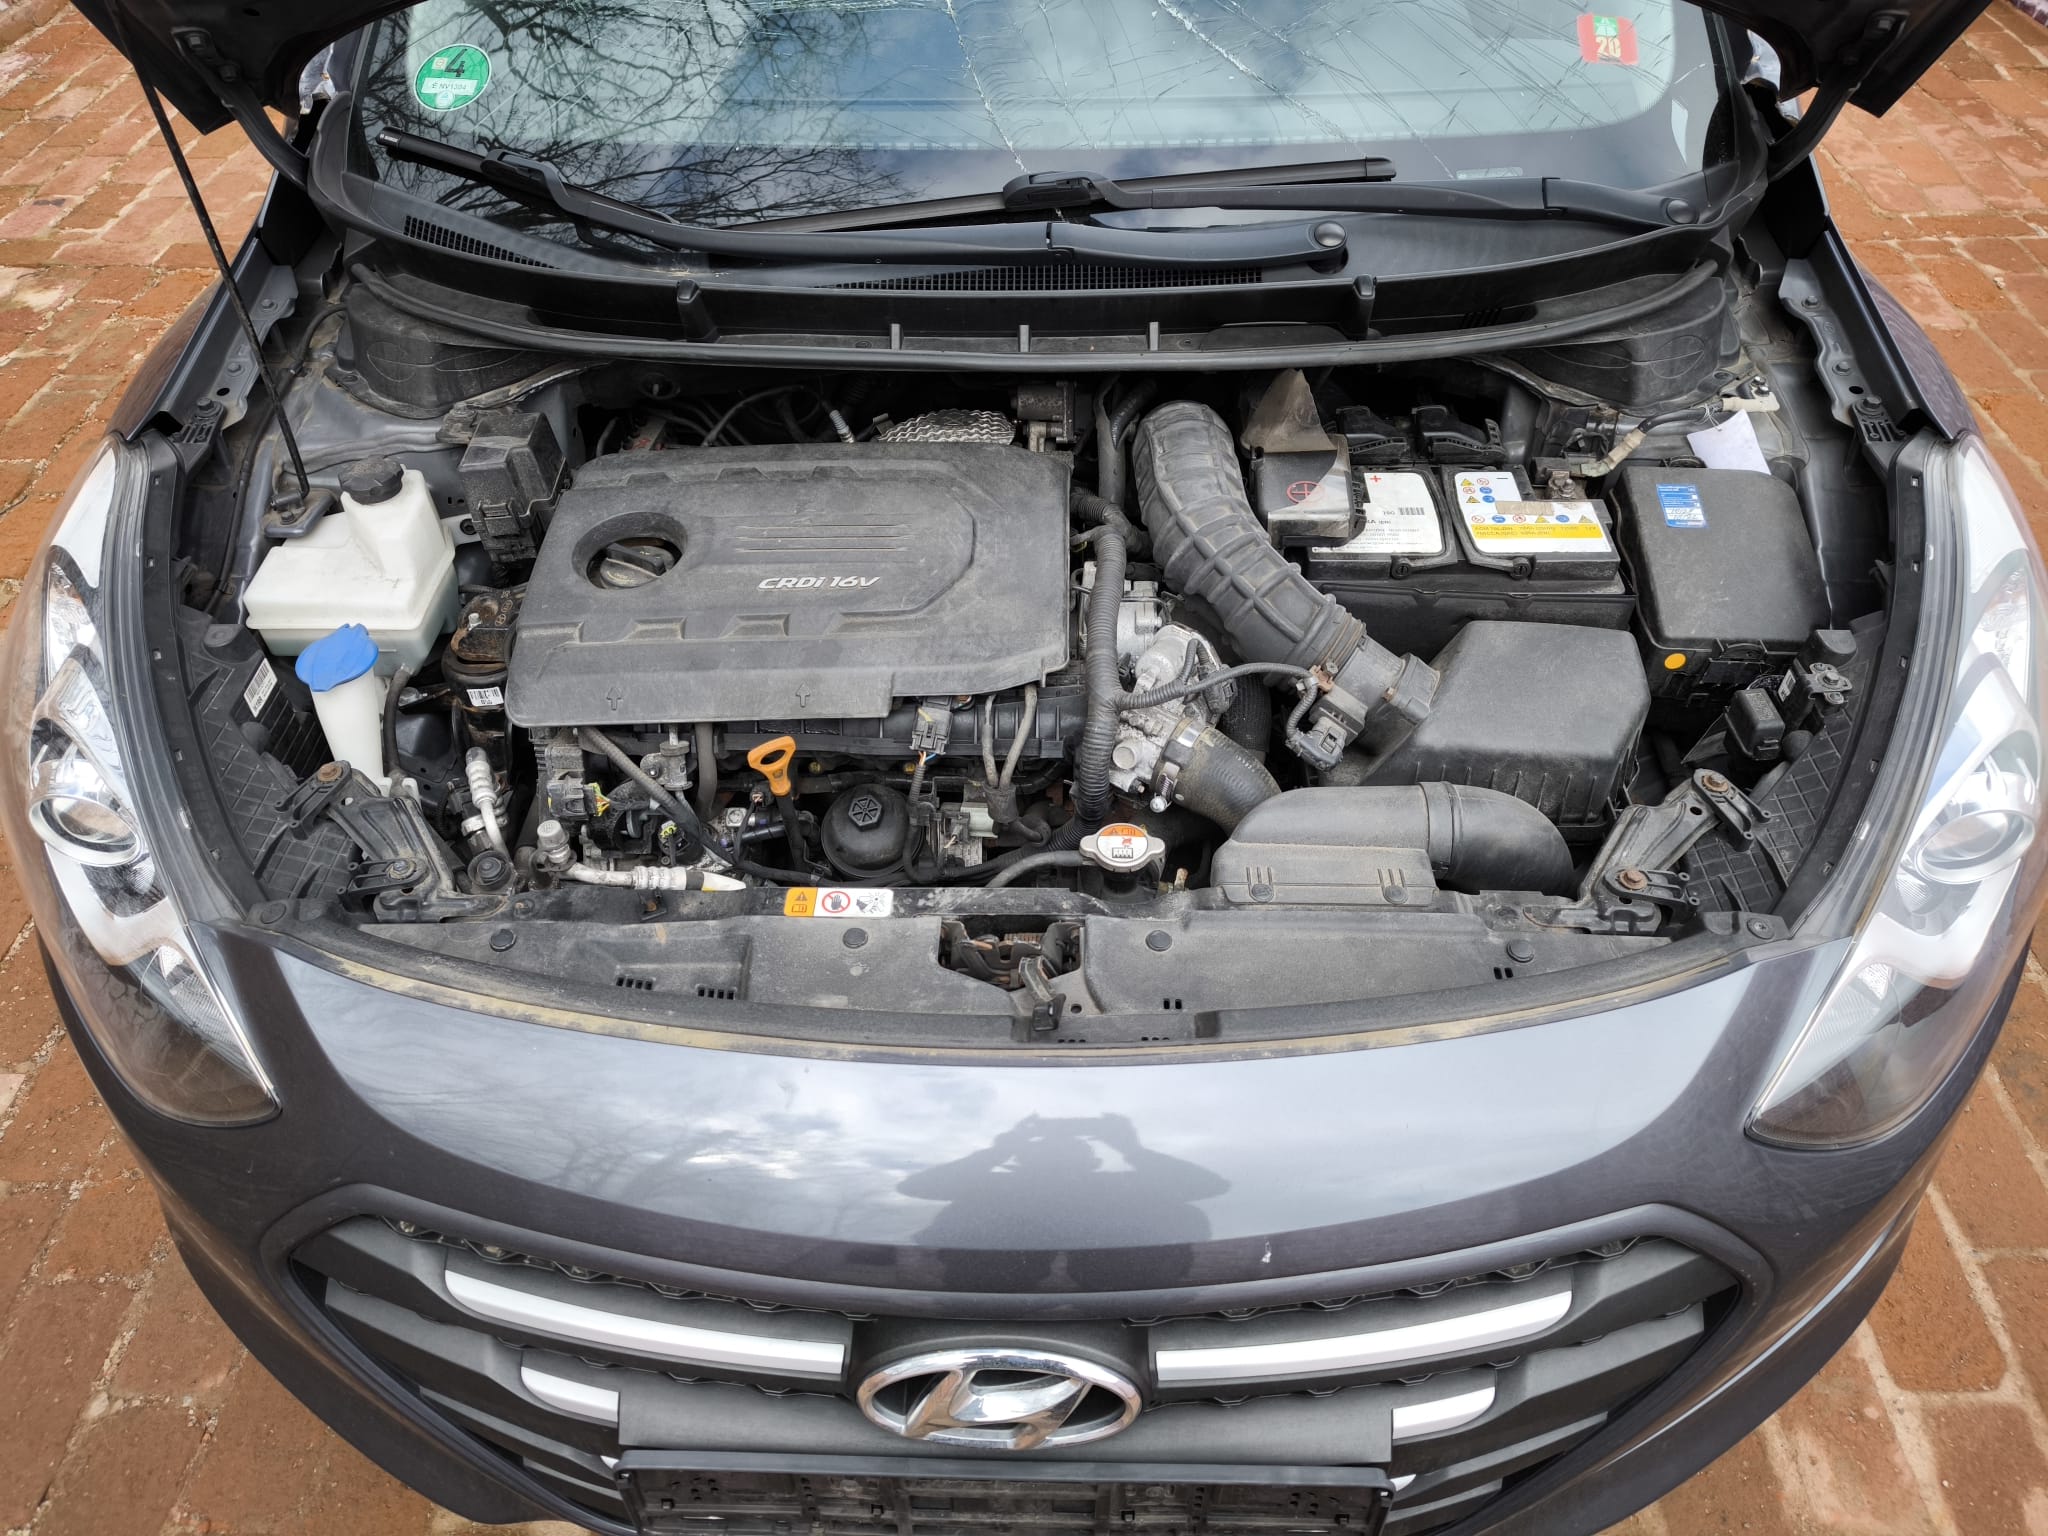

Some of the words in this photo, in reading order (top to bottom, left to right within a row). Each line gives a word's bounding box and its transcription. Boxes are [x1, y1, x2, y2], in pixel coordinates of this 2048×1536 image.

[444, 48, 467, 77] 4
[758, 576, 825, 589] CRDi
[830, 576, 881, 588] 16V
